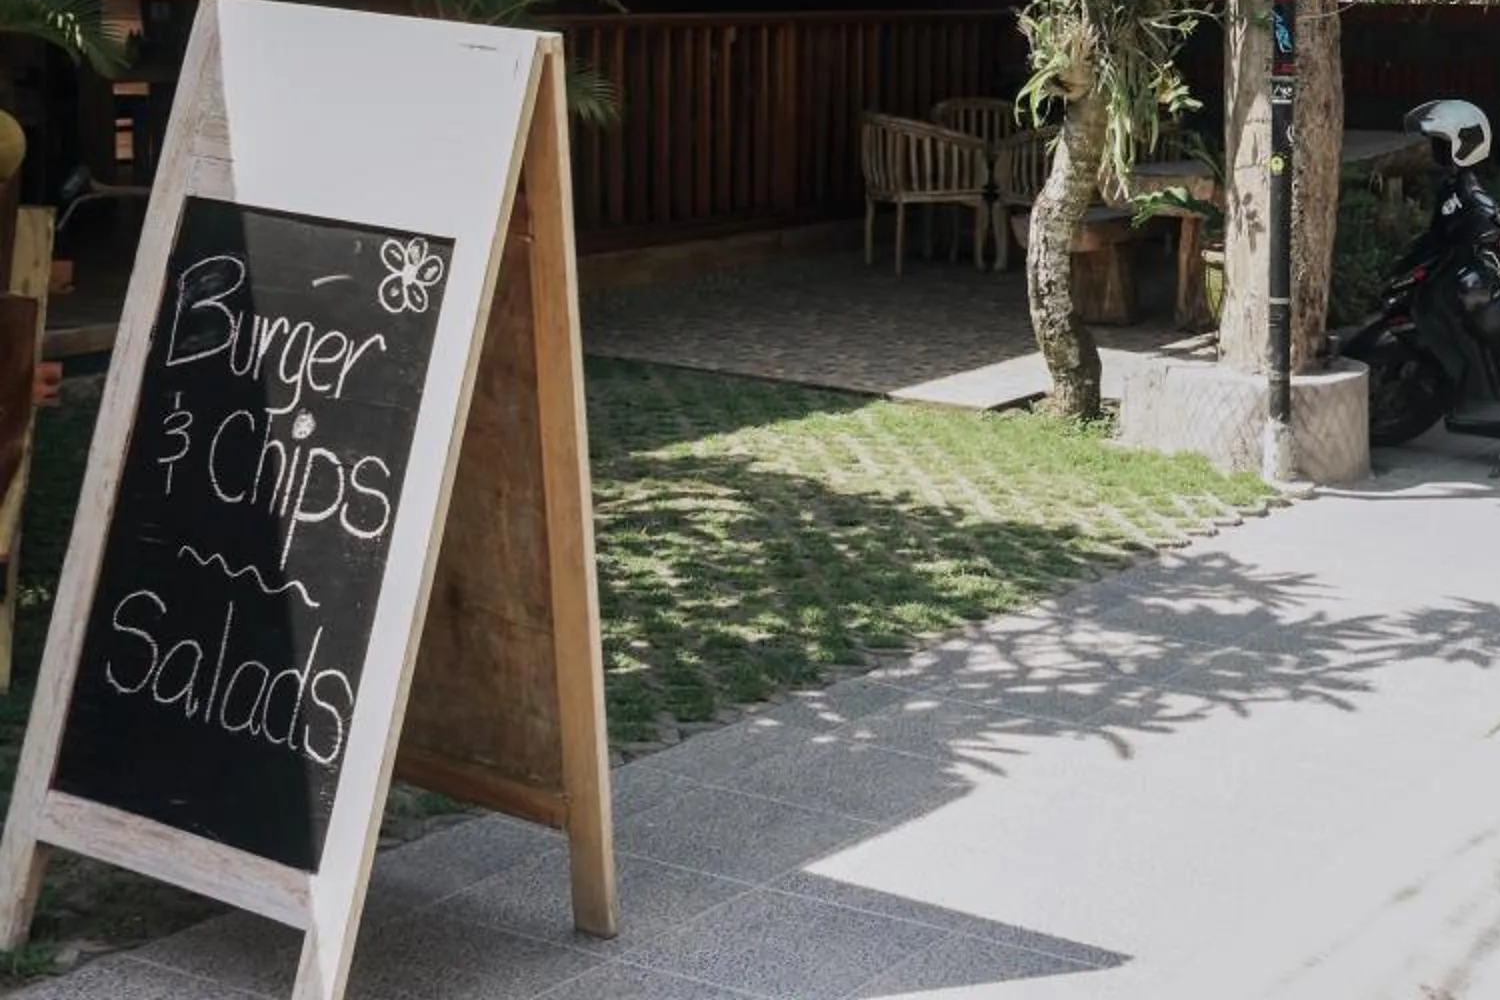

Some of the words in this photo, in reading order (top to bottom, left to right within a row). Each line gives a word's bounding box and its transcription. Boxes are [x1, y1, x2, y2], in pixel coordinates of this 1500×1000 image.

[166, 255, 387, 413] Burger
[208, 410, 391, 571] Chips
[106, 590, 354, 764] Salads
